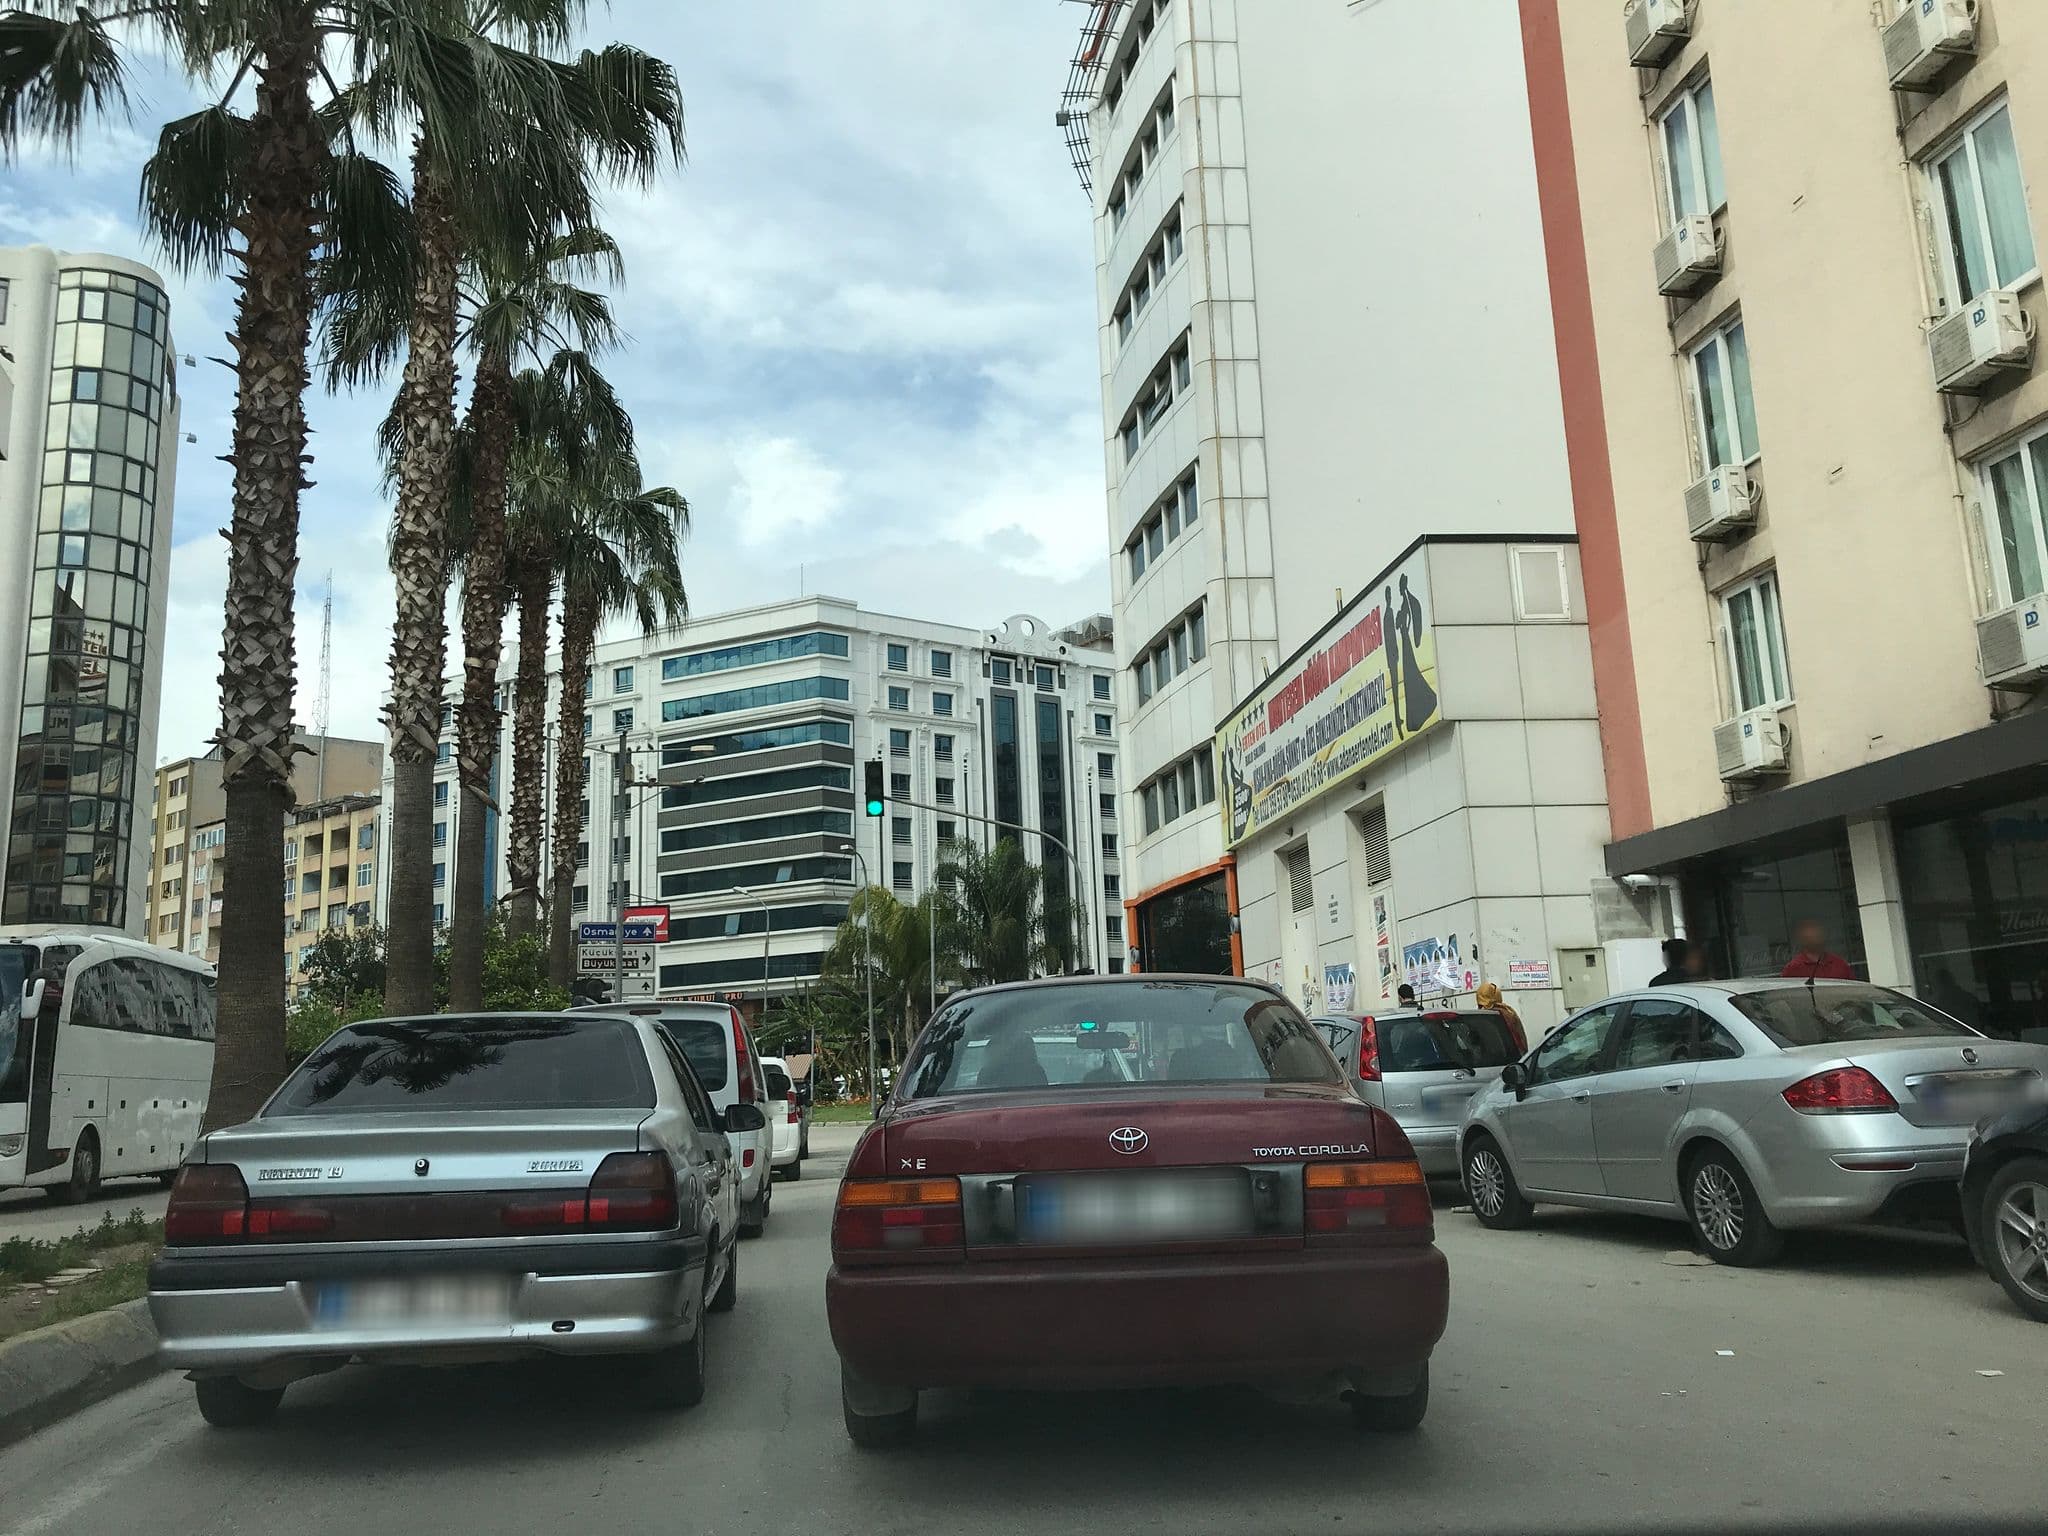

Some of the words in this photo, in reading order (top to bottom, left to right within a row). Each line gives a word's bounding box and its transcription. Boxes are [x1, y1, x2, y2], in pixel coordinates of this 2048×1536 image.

[583, 927, 637, 937] Osmaye
[582, 948, 638, 957] Küçükaat
[583, 959, 637, 969] Büyükaat
[1252, 1146, 1296, 1157] TOYOTA
[1299, 1143, 1370, 1156] COROLLA
